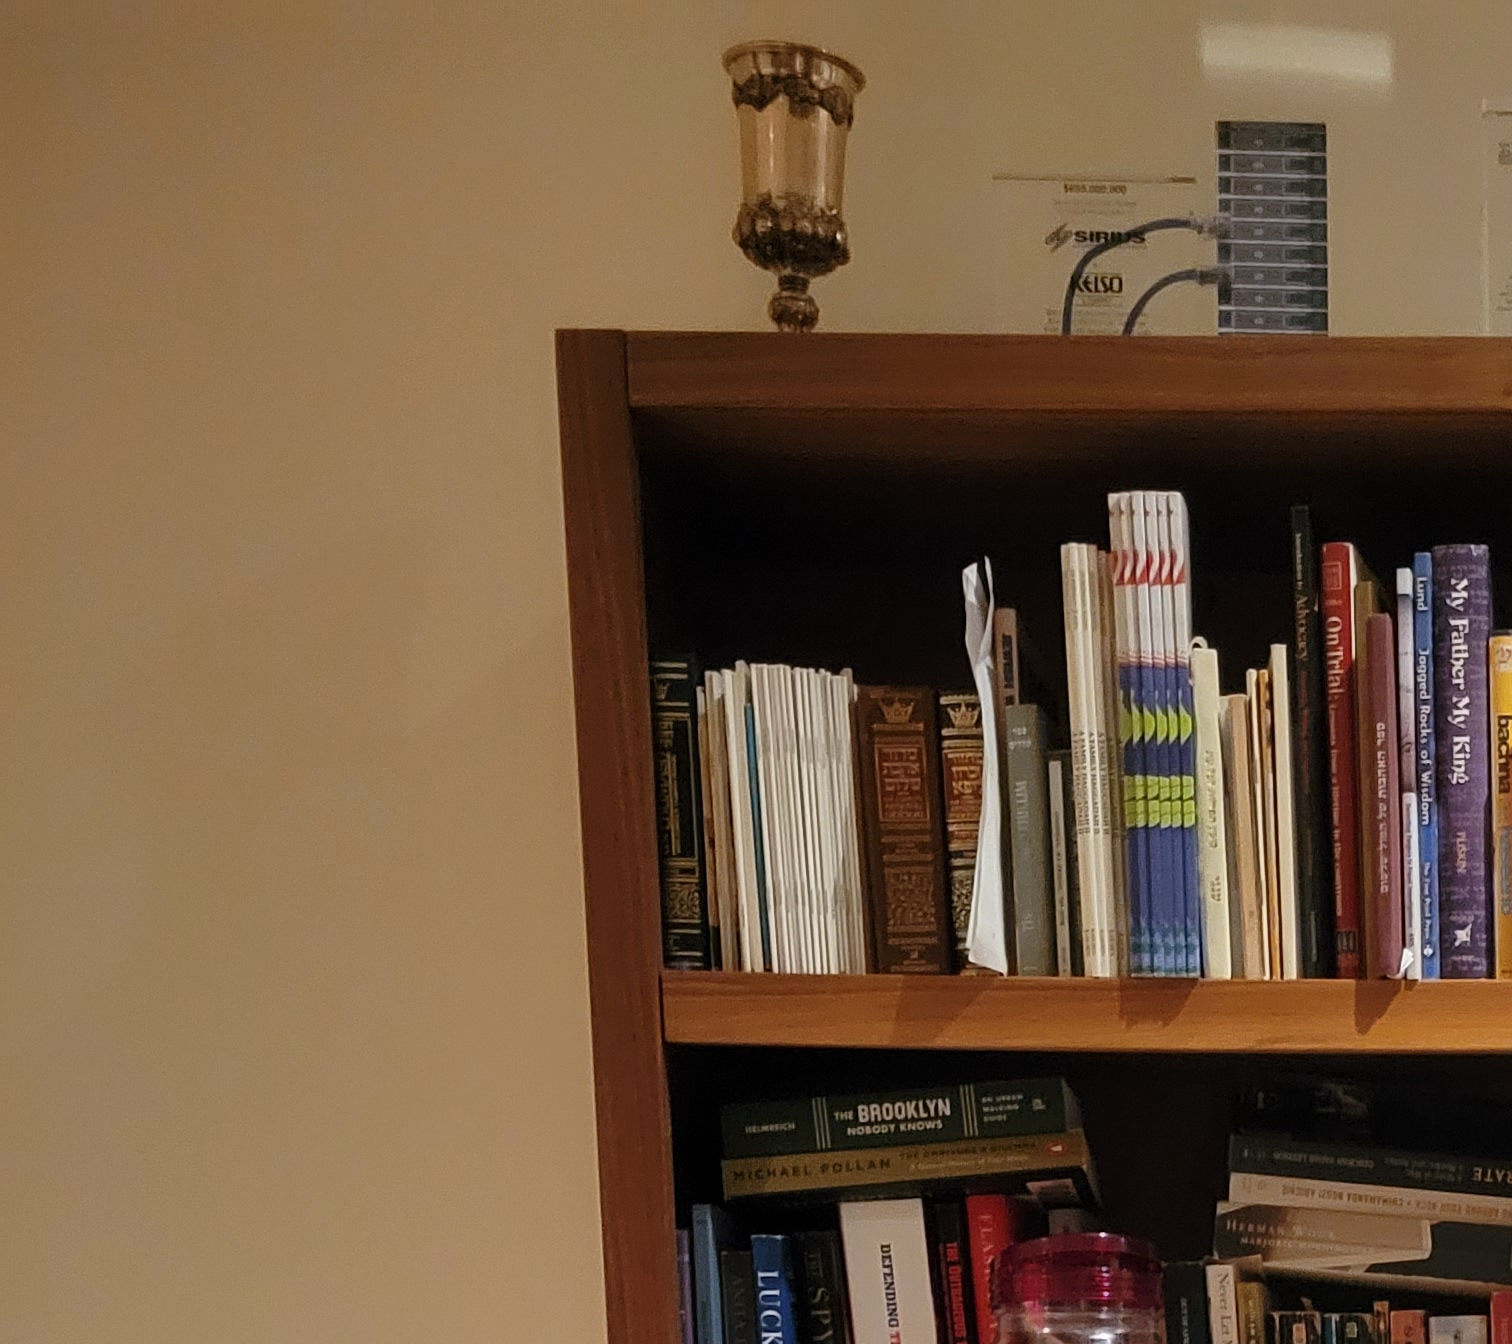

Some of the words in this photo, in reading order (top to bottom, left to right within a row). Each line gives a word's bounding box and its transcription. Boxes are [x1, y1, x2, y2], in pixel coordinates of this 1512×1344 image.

[1415, 577, 1429, 611] Lund
[1446, 577, 1469, 611] My
[1448, 618, 1470, 690] Father
[1416, 648, 1432, 700] Jagged
[1418, 705, 1432, 744] Rocks
[1448, 696, 1471, 730] My
[1419, 750, 1433, 766] of
[1449, 736, 1472, 784] King
[1420, 770, 1434, 825] Wisdom
[834, 1110, 855, 1122] THE
[857, 1097, 952, 1123] BROOKLYN
[846, 1123, 896, 1136] NOBODY
[899, 1119, 944, 1133] KNOWS
[879, 1243, 901, 1329] DEFENDING
[1215, 1273, 1231, 1312] Never
[1218, 1315, 1232, 1337] Let
